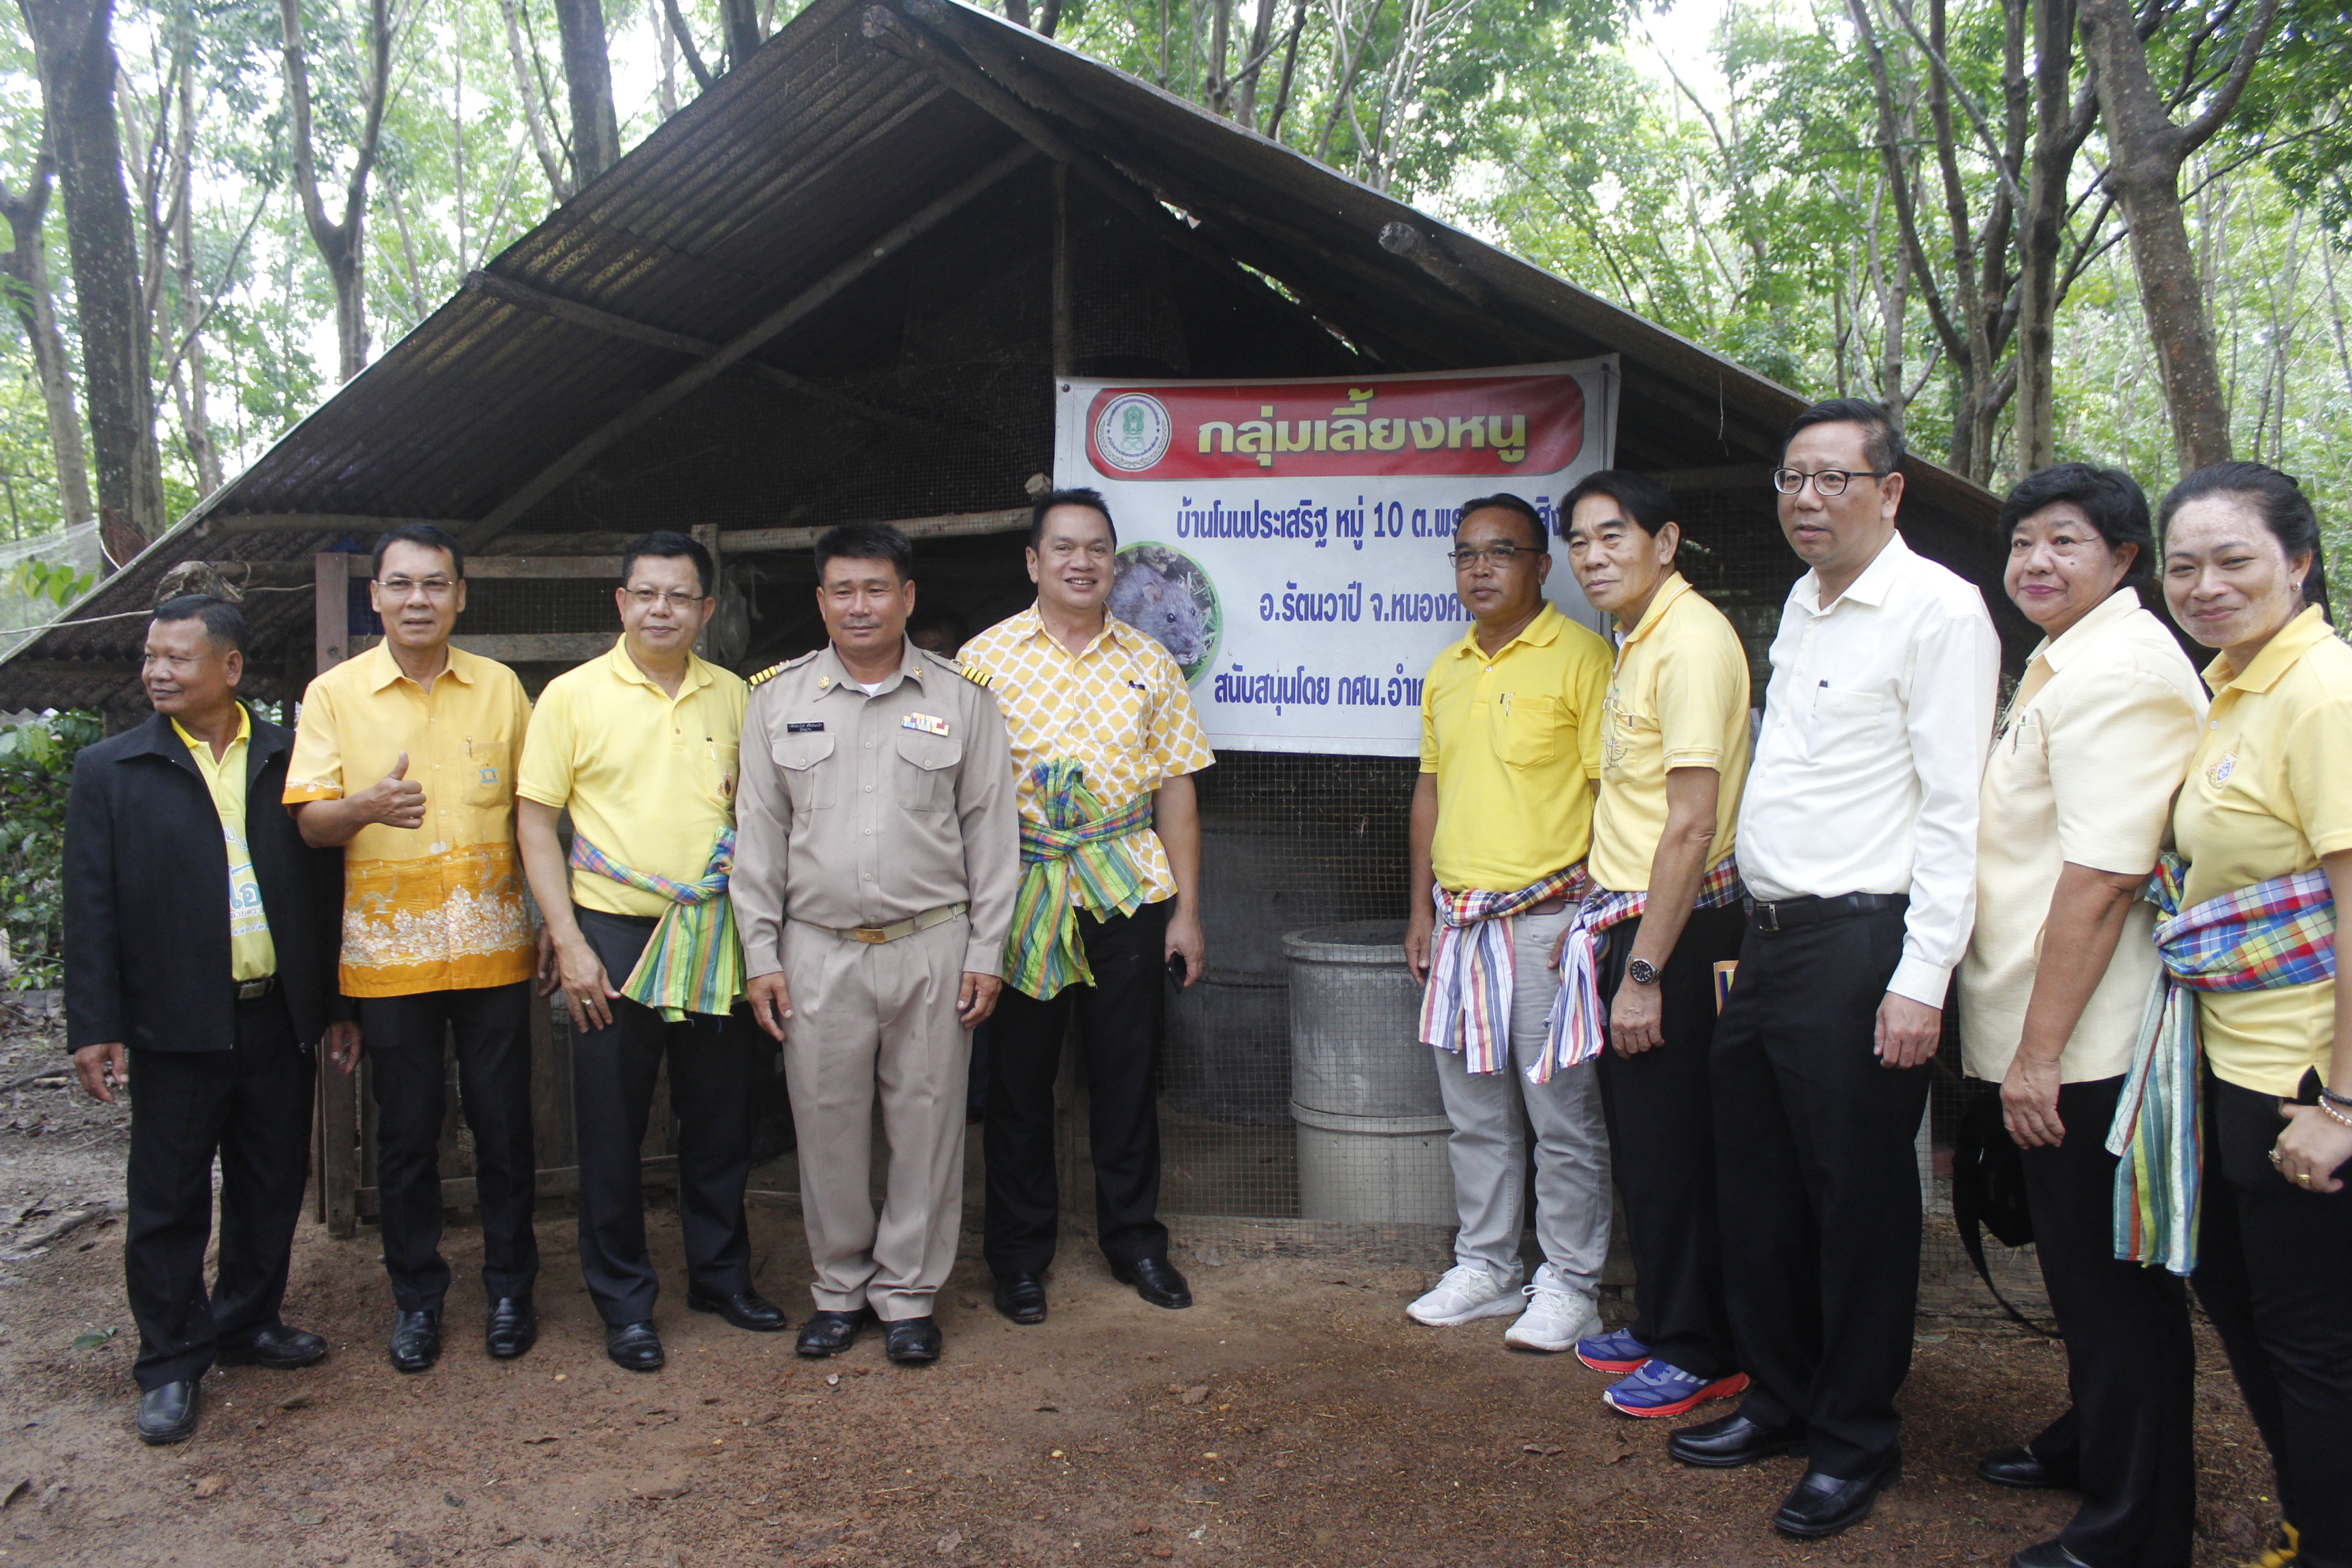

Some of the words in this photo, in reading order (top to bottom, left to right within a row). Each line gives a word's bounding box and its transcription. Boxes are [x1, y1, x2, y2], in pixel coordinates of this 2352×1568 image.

[1198, 389, 1526, 466] กลุ่มเลี้ยงหนู
[1177, 496, 1328, 548] บ้านโนนประเสริฐ
[1336, 495, 1364, 551] หมู่
[1374, 501, 1403, 538] 10
[1260, 581, 1362, 622] อ.รัตนวาปี
[1215, 662, 1330, 716] สนับสนุนโดย
